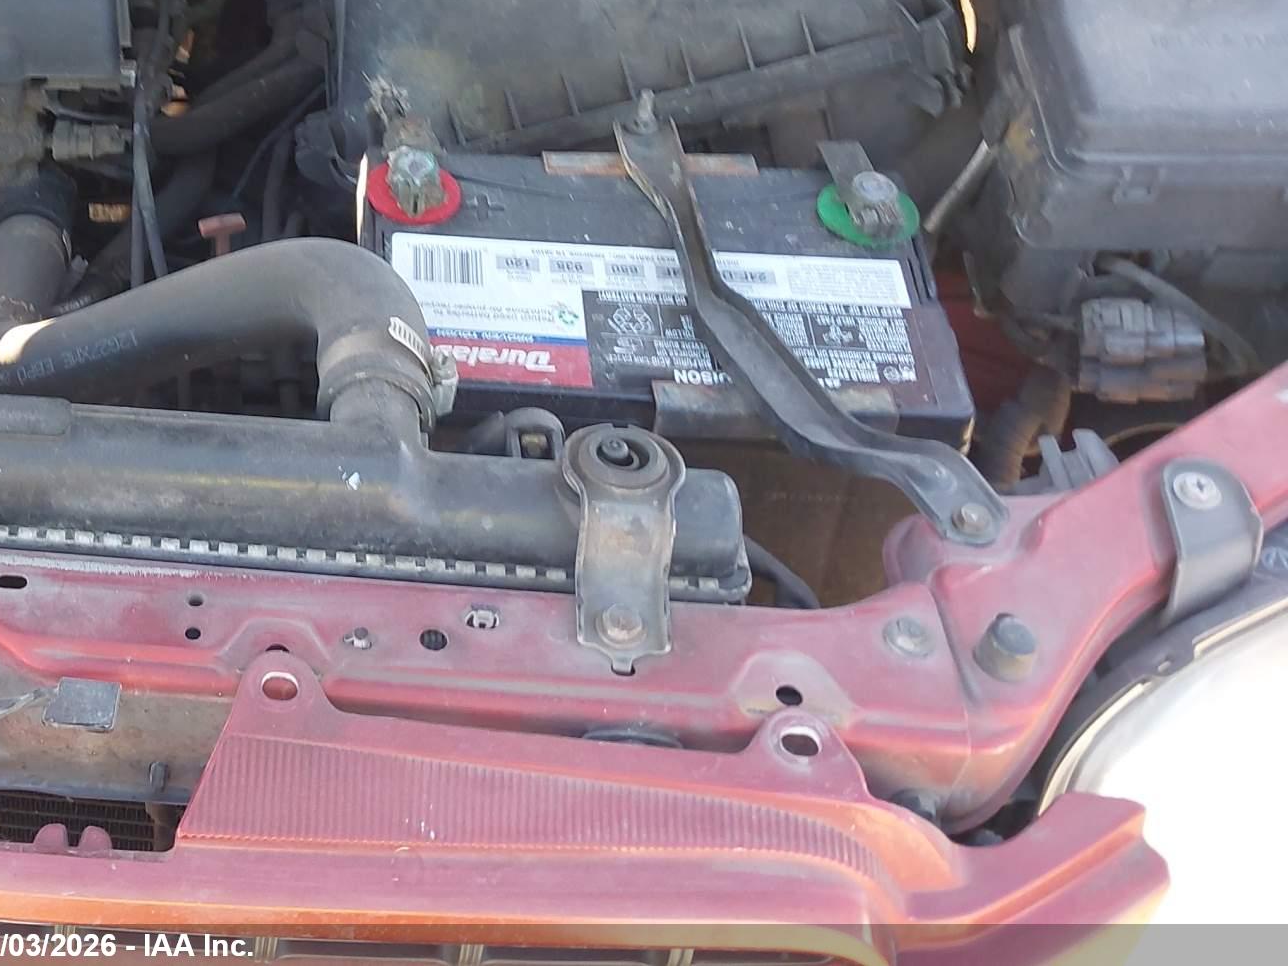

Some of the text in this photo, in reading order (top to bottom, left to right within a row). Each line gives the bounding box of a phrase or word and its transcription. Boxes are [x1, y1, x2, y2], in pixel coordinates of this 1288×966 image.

[636, 293, 657, 304] OPEN
[658, 294, 674, 305] NOT
[674, 295, 688, 306] DO
[800, 302, 828, 314] REACH
[829, 304, 846, 315] THE
[861, 305, 879, 317] OUT
[881, 306, 903, 318] KEEP
[493, 312, 517, 322] used
[836, 316, 856, 327] HELP
[429, 343, 556, 373] Durala
[829, 349, 871, 362] BLINDNESS
[872, 352, 899, 363] CAUSE
[899, 353, 914, 364] CAN
[651, 355, 671, 368] ACID
[674, 369, 731, 385] ISON
